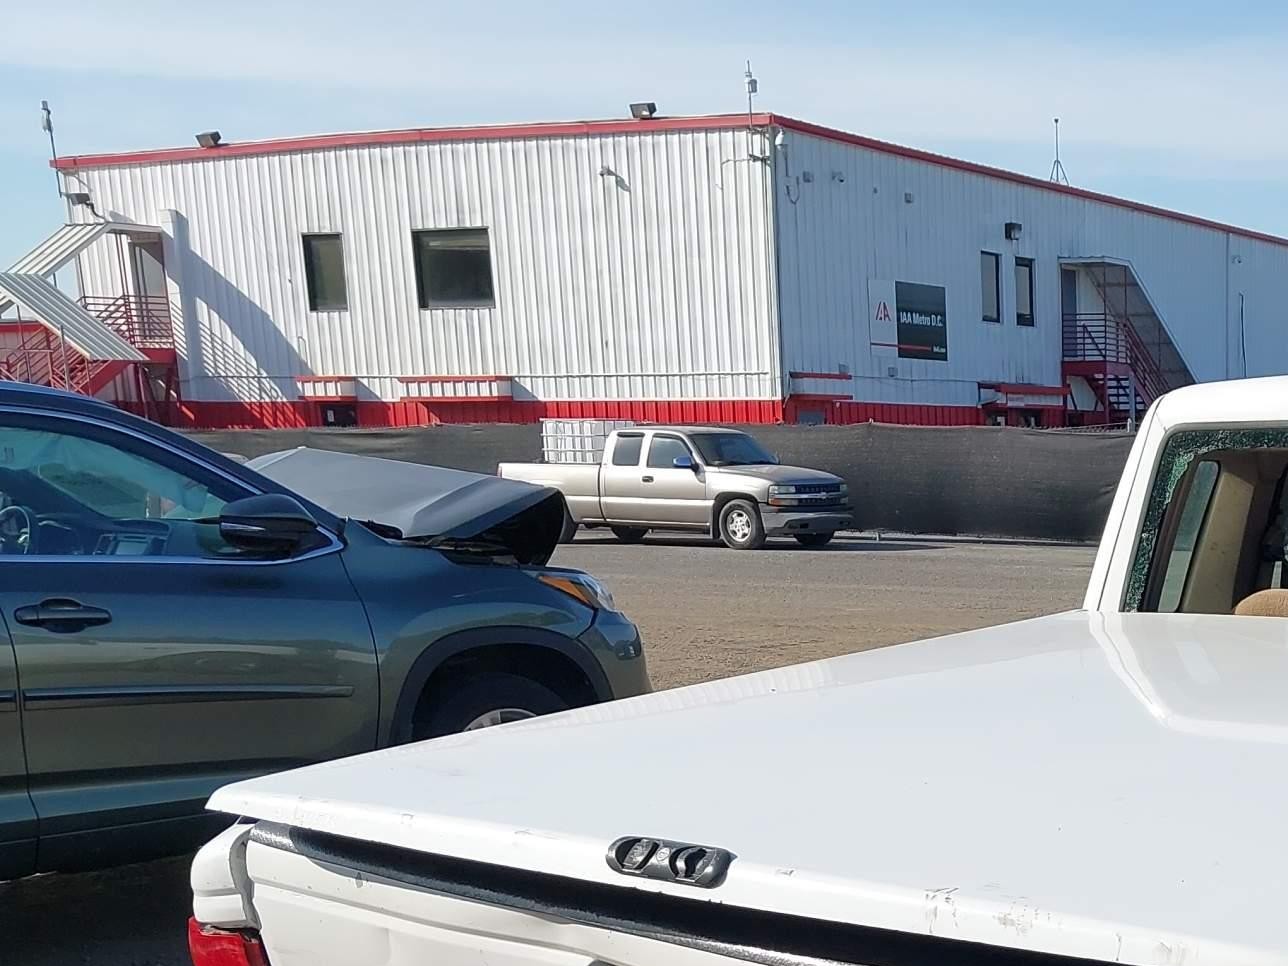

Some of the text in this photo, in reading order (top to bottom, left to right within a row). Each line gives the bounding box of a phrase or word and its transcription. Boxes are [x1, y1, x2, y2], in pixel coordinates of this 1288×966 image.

[900, 311, 944, 327] IAA Metro D.C.
